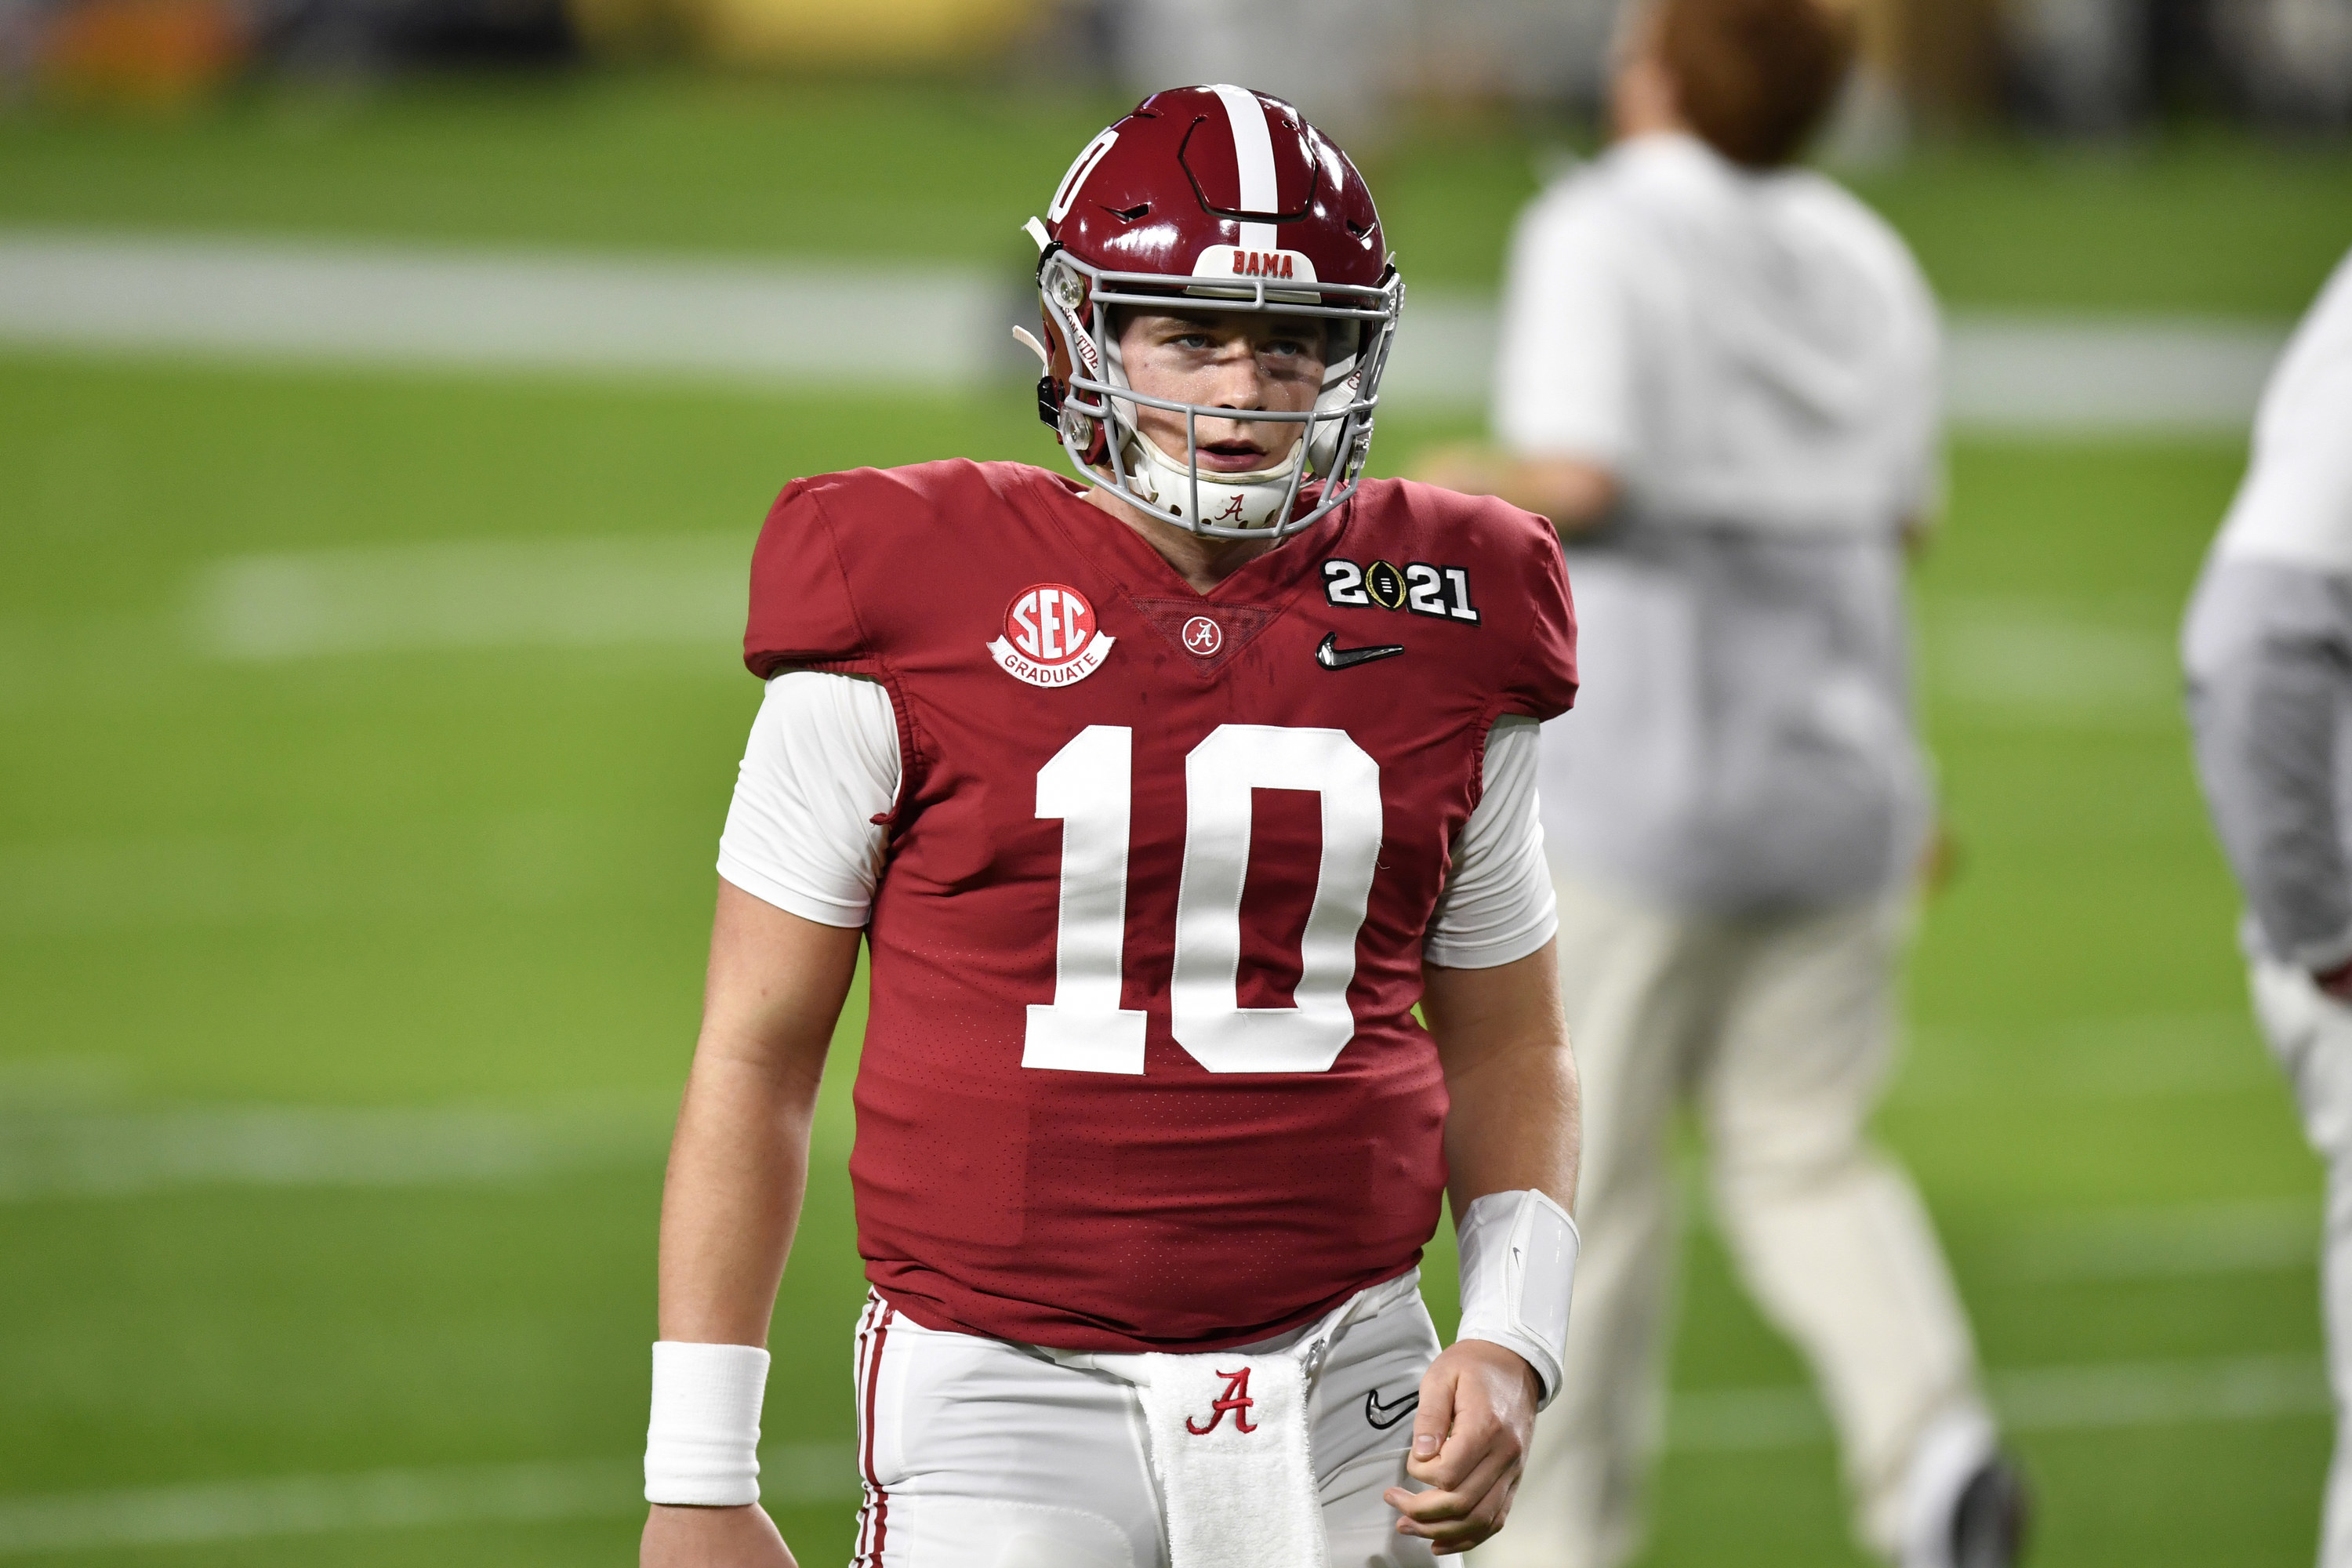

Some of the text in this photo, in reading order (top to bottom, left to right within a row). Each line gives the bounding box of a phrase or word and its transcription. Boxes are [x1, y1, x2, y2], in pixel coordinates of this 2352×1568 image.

[1047, 126, 1119, 224] 0
[1232, 250, 1293, 278] BAMA
[1214, 494, 1244, 521] A
[1013, 589, 1087, 659] SEC
[1189, 622, 1214, 647] A
[1004, 652, 1098, 684] GRADUATE
[1021, 724, 1383, 1076] 10
[1185, 1367, 1258, 1436] A
